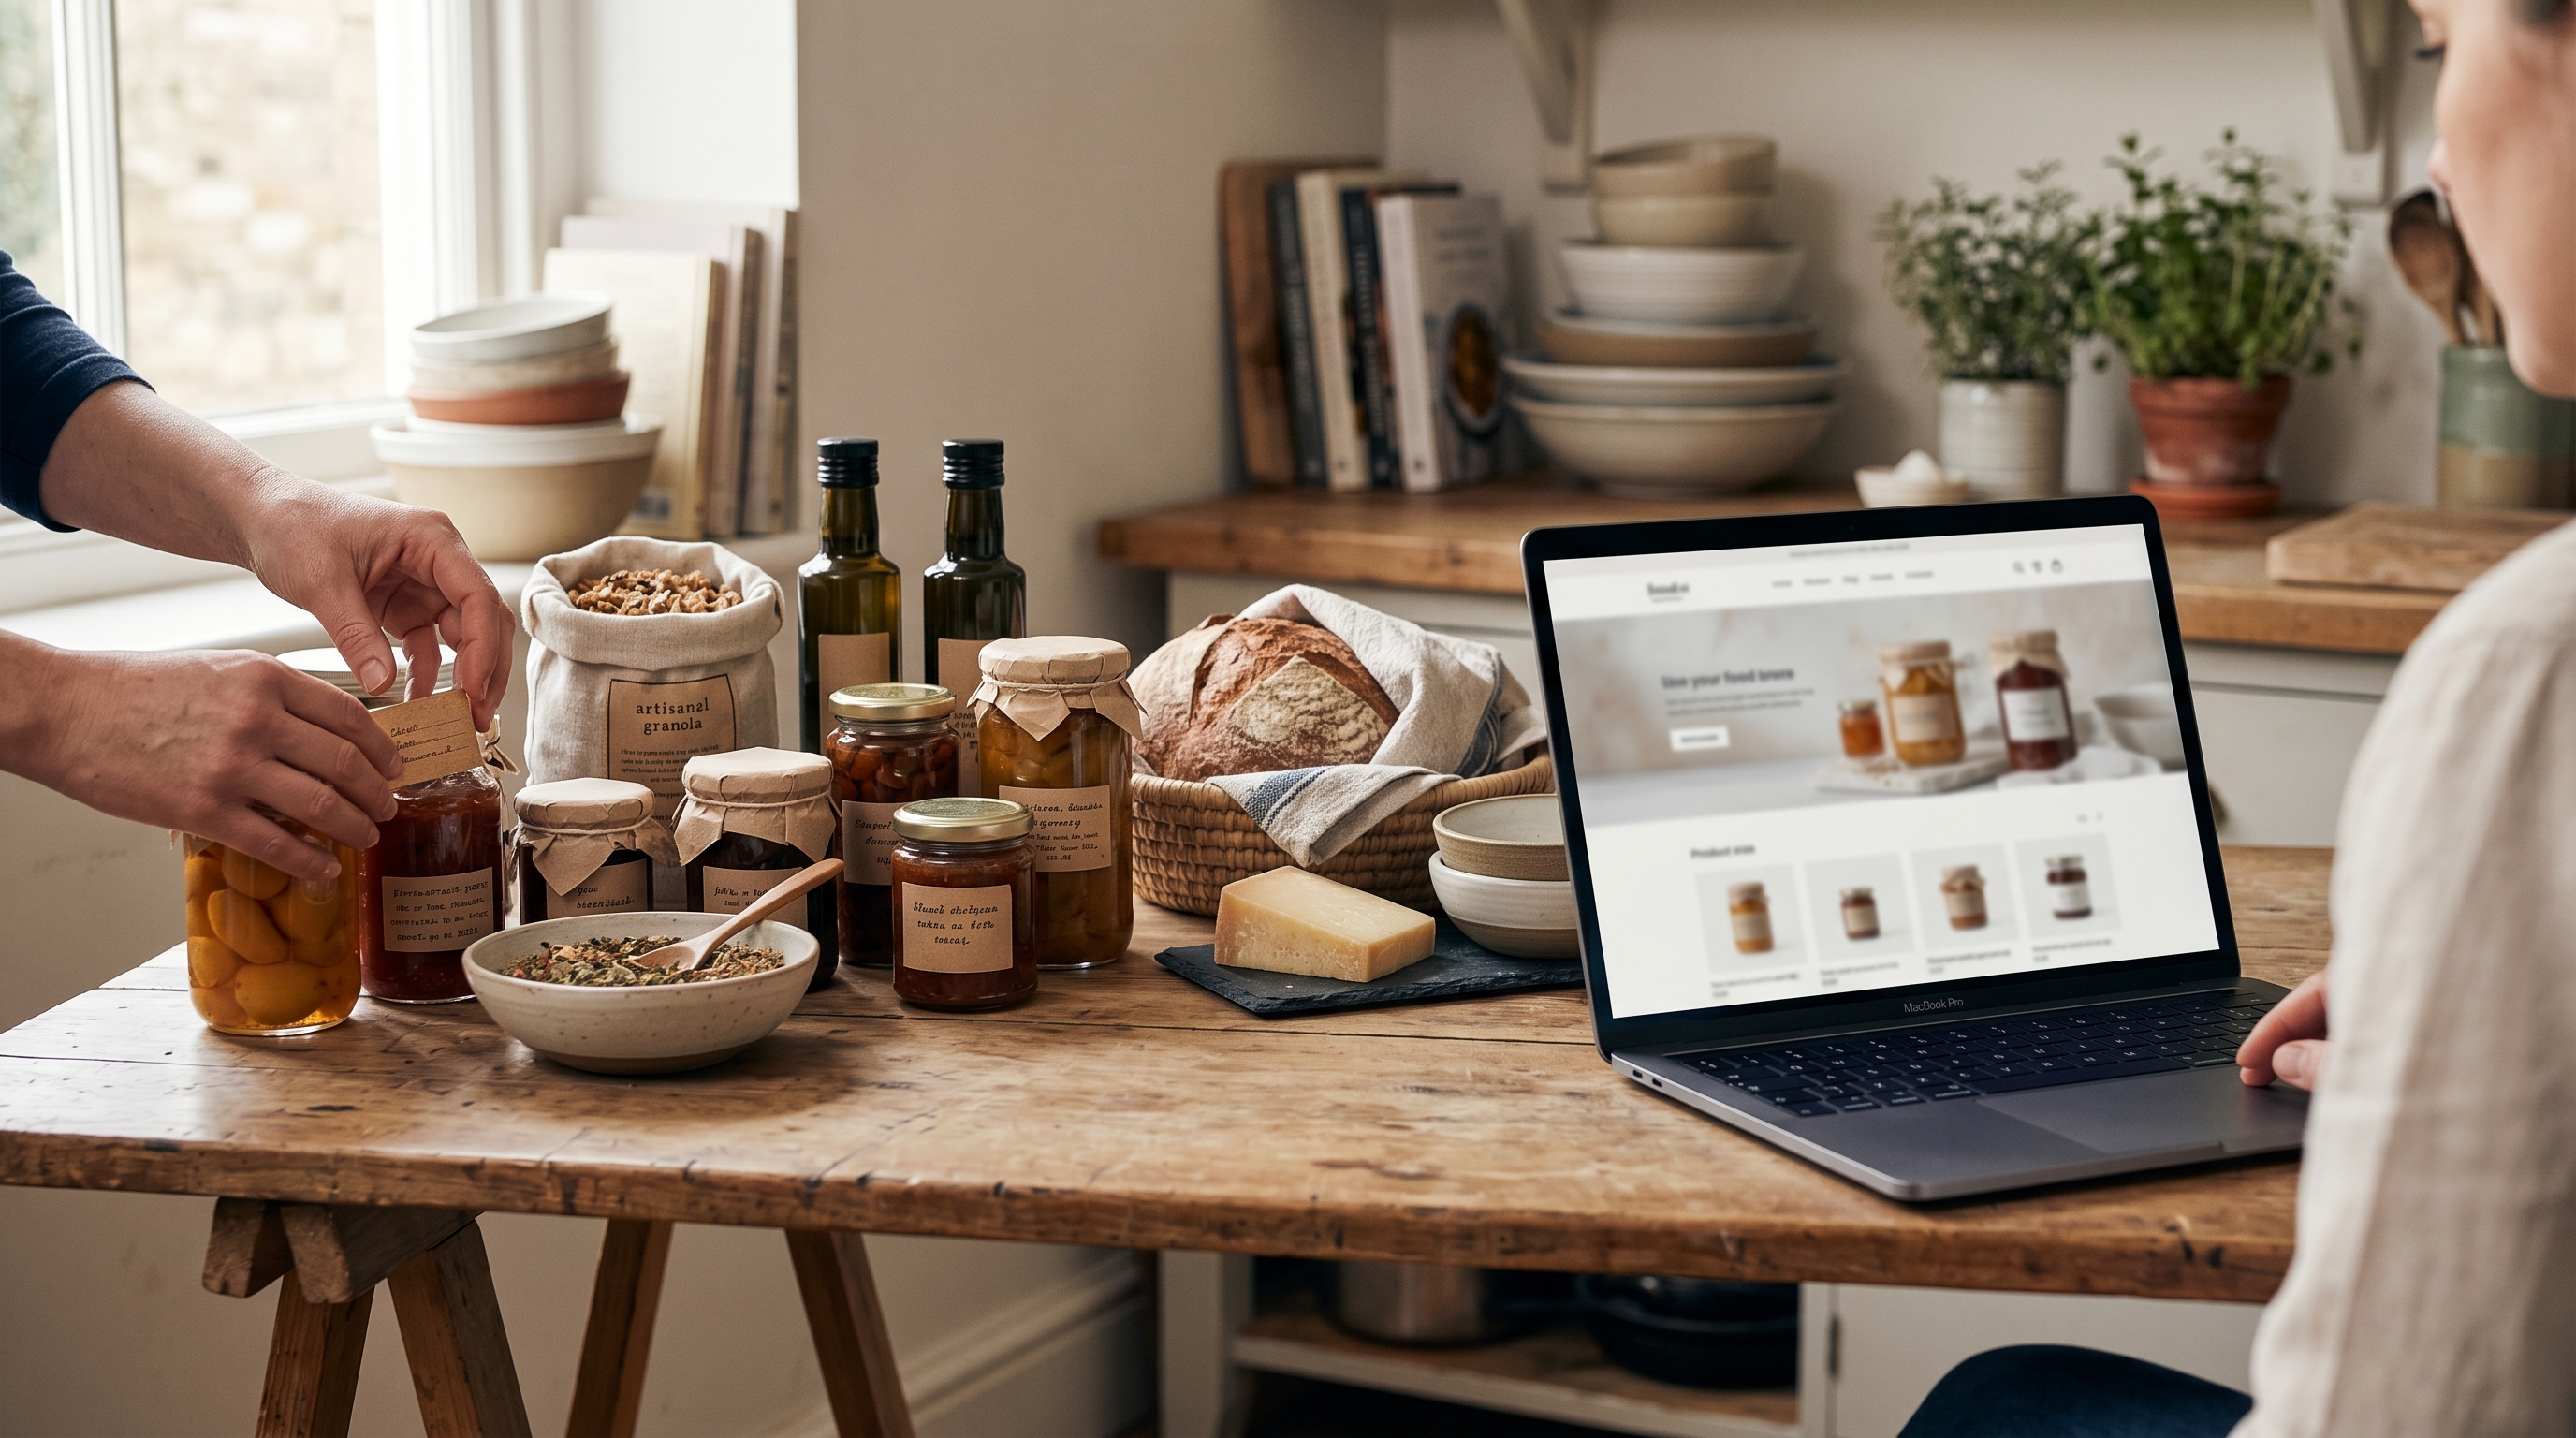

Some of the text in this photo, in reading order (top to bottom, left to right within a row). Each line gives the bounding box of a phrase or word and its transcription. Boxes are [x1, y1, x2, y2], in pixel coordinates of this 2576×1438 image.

[643, 717, 703, 736] granola
[1903, 997, 1964, 1013] MacBook Pro
